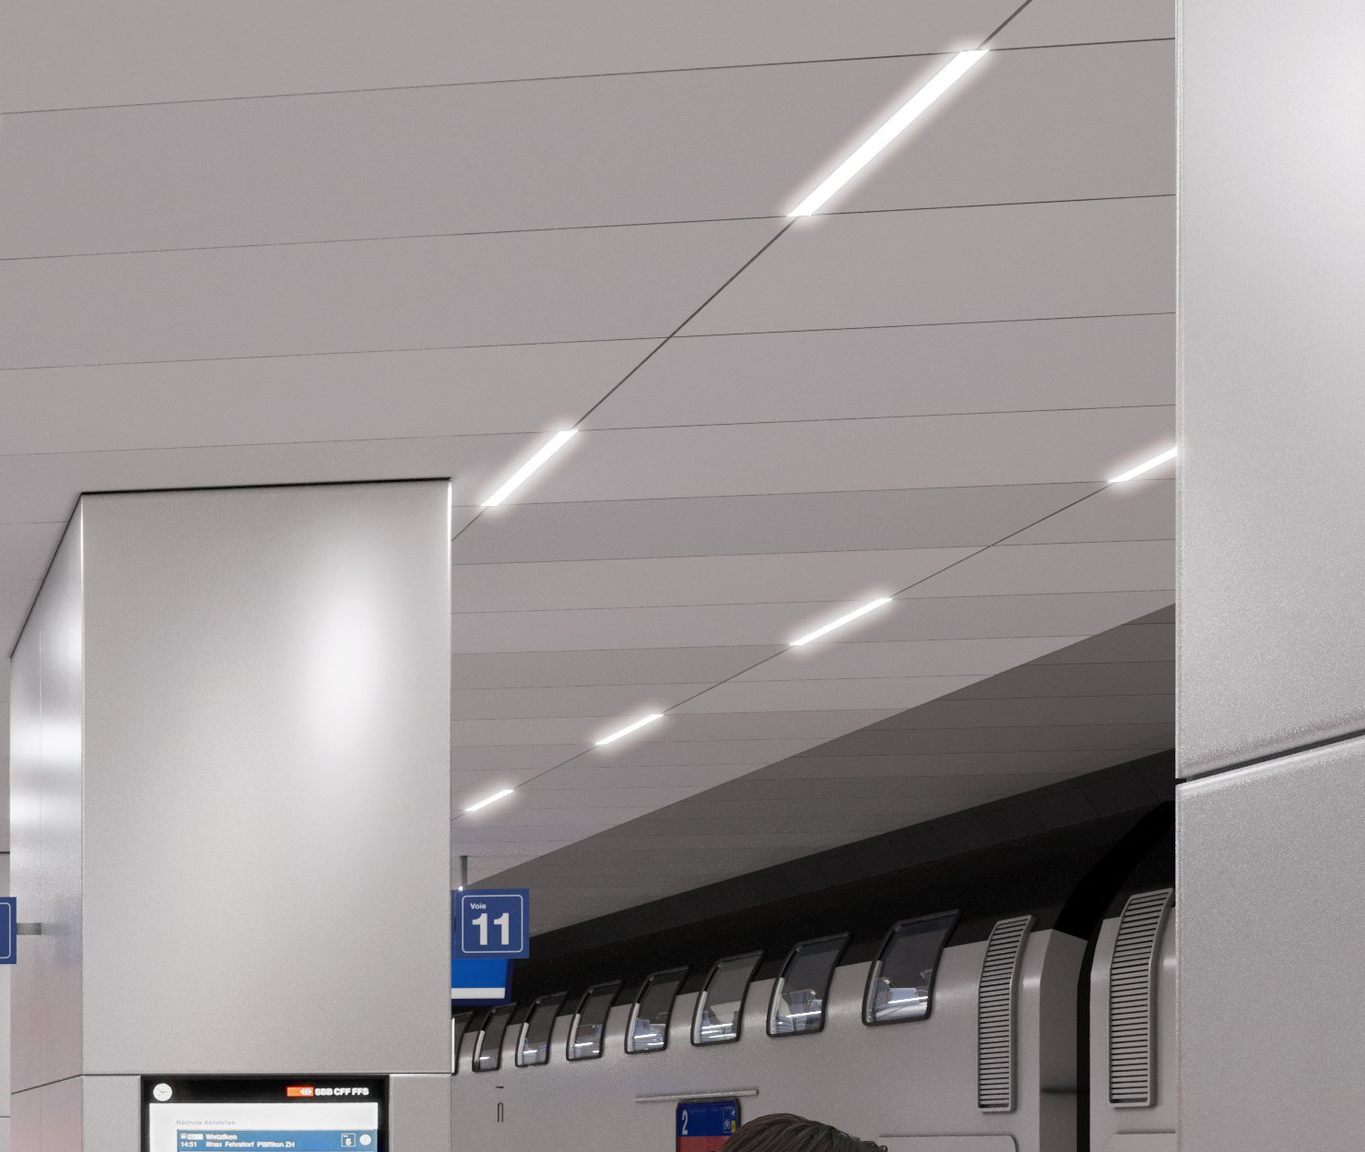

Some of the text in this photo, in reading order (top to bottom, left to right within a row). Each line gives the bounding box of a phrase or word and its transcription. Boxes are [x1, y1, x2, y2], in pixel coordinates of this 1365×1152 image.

[472, 913, 509, 945] 11
[315, 1088, 370, 1096] SBB CFF FFS
[682, 1109, 689, 1136] 2
